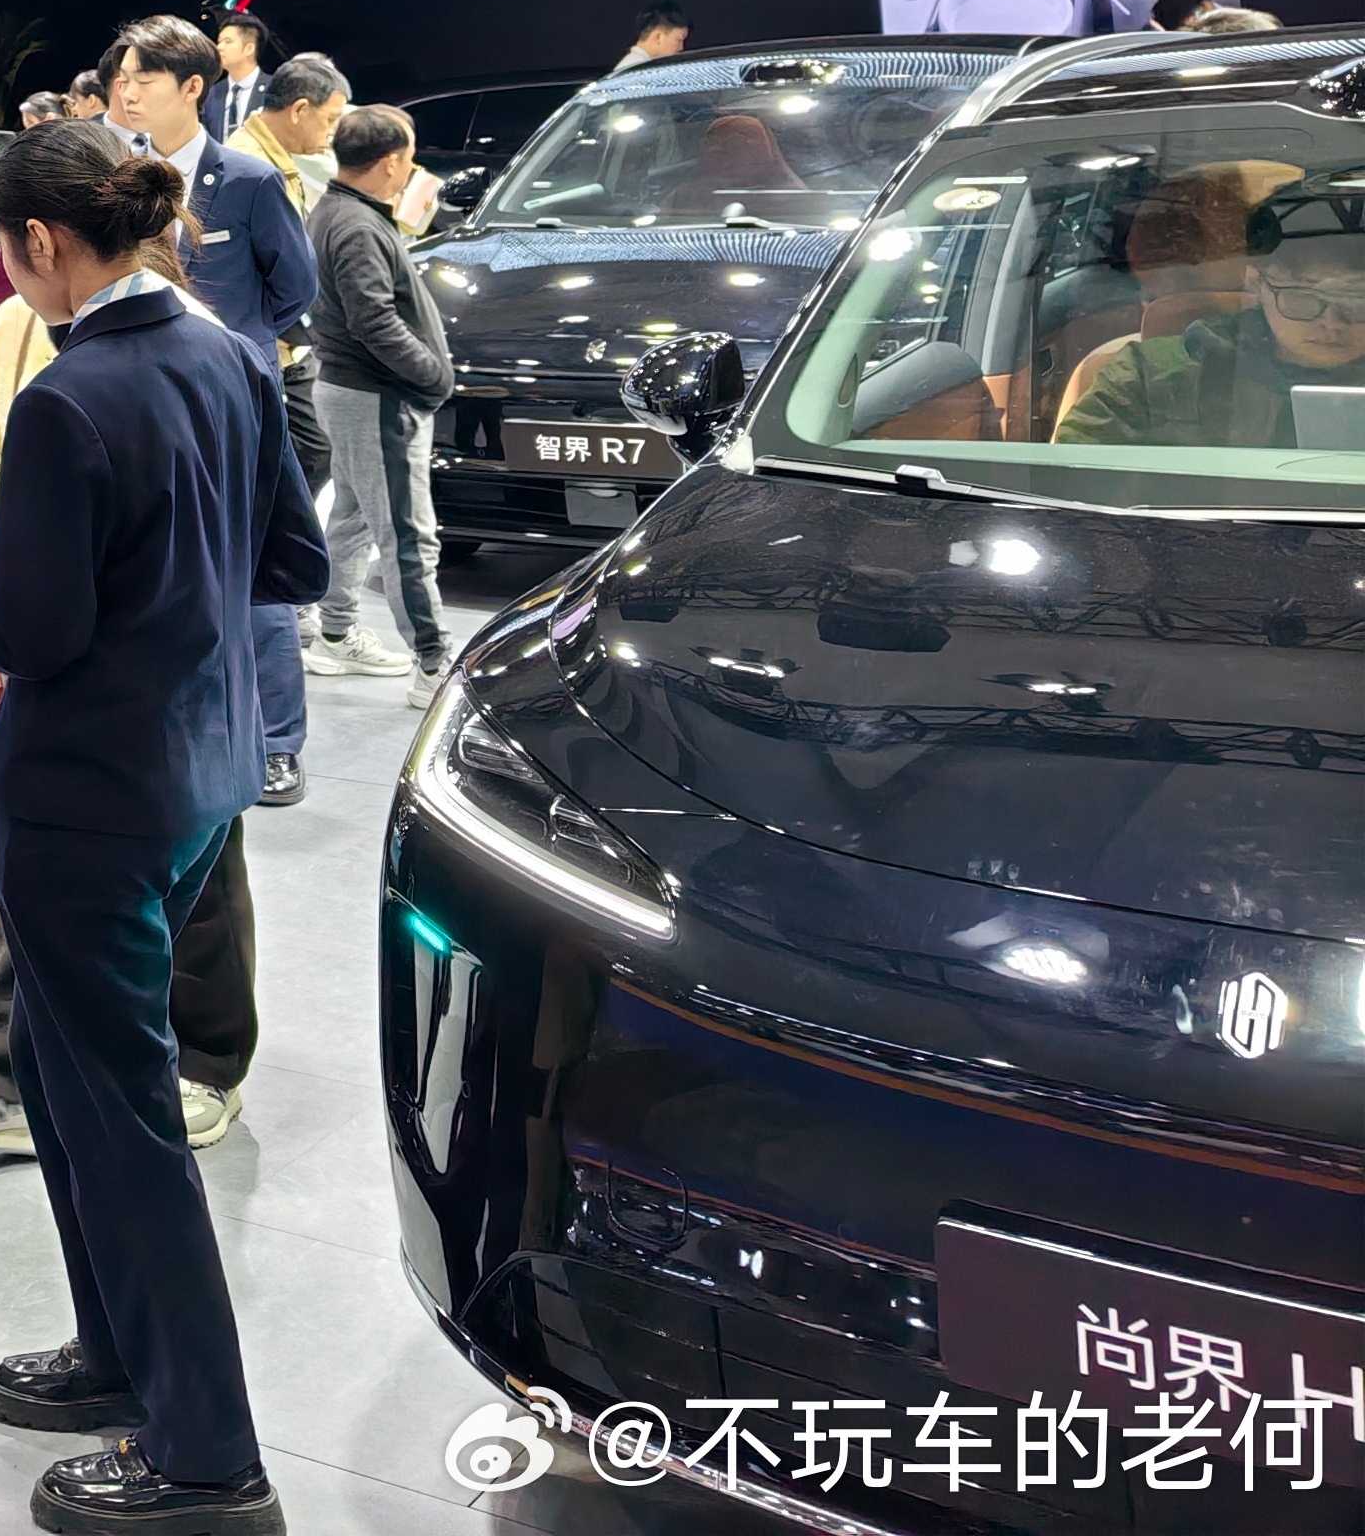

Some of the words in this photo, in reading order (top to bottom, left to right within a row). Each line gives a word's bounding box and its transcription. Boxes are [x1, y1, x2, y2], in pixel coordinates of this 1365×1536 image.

[535, 433, 592, 463] 智界
[601, 437, 646, 465] R7
[1072, 1302, 1254, 1413] 尚界
